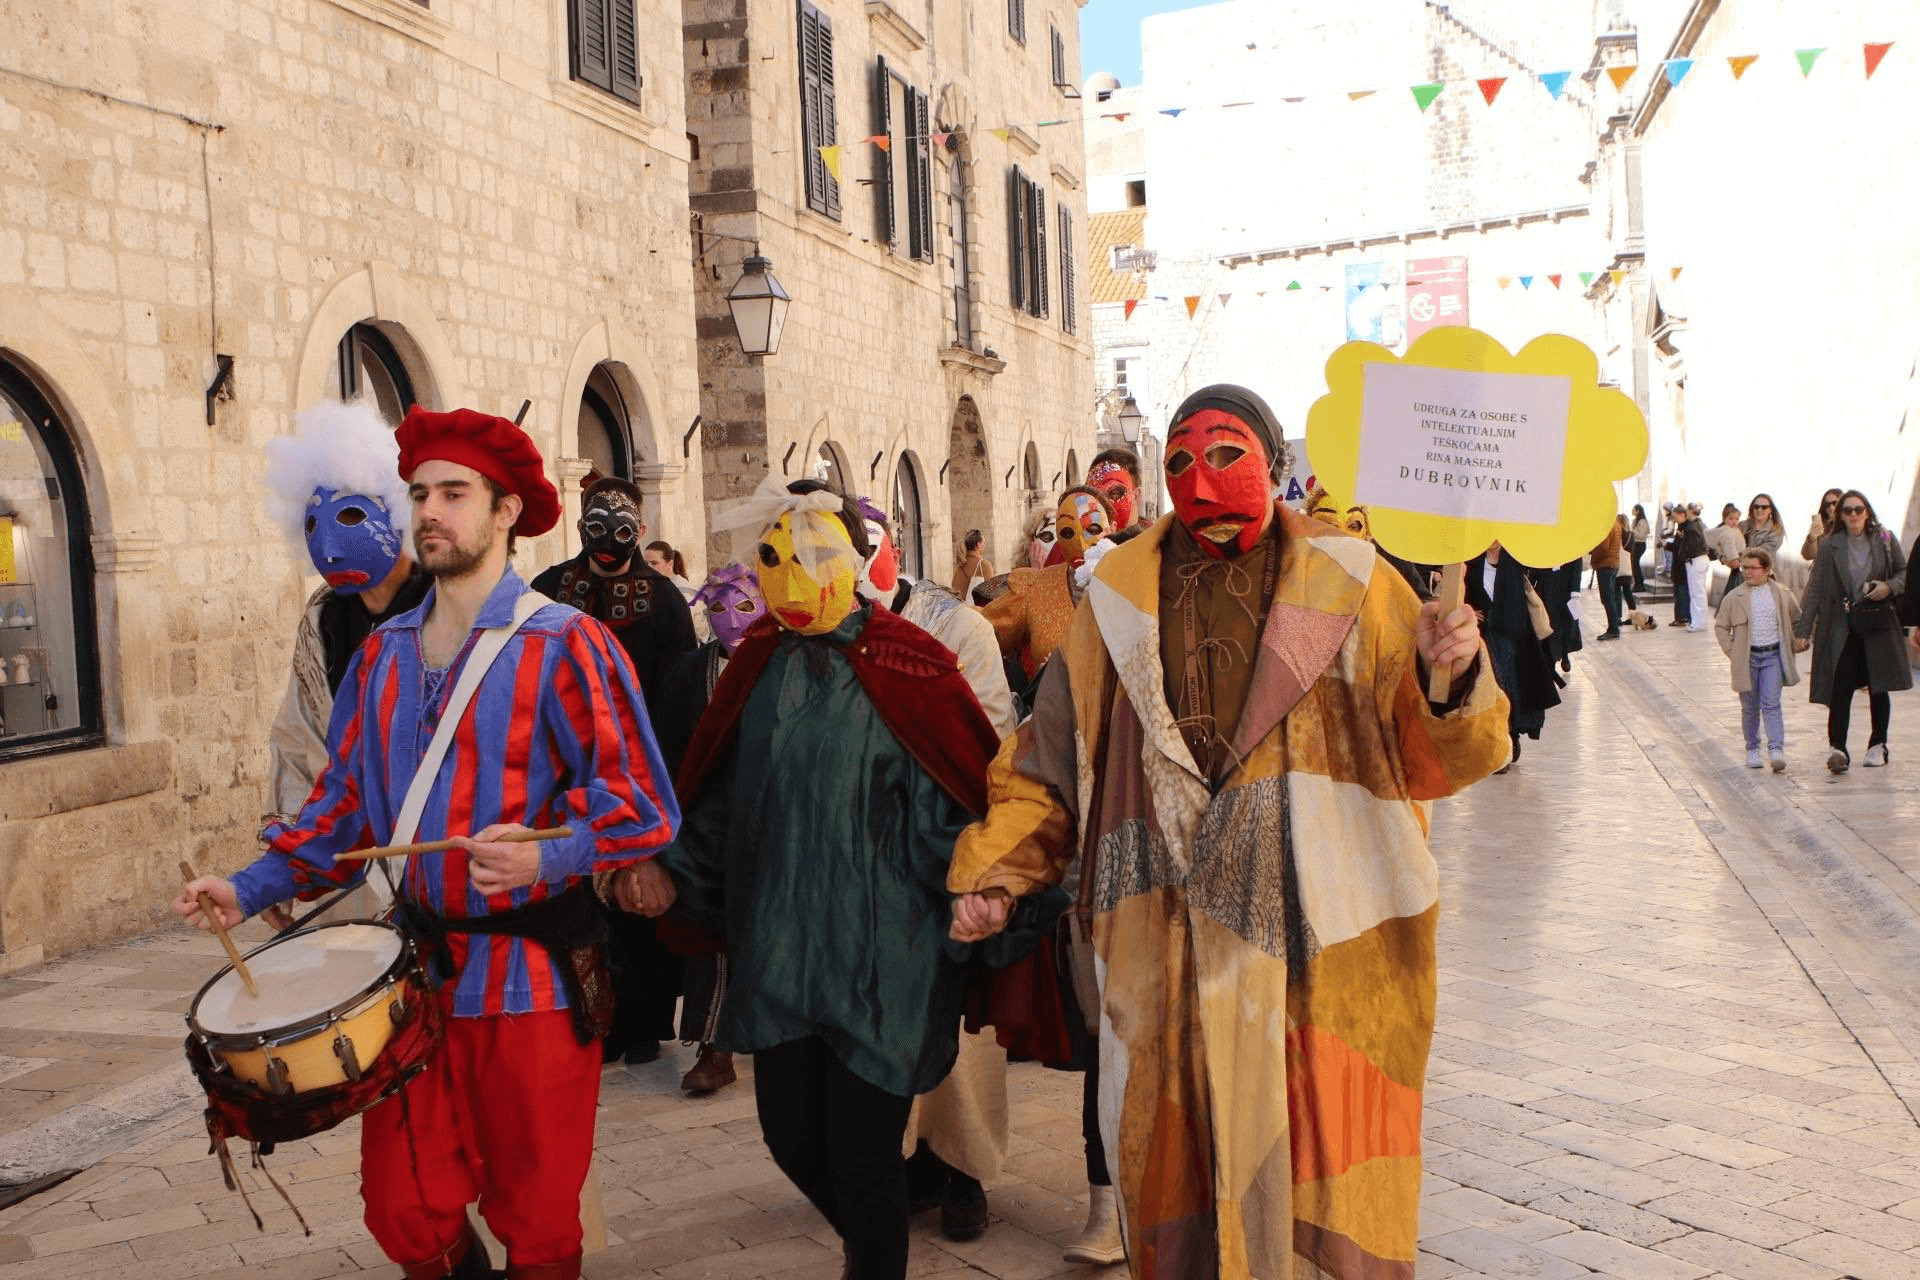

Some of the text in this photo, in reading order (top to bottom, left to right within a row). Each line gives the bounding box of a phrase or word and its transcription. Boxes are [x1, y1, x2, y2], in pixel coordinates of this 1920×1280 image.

[1413, 402, 1528, 424] UDRUGA ZA OSOBE S
[1421, 419, 1515, 438] INTELEKTUALNIM
[1426, 452, 1450, 464] RINA
[1400, 465, 1526, 493] DUBROVNIK
